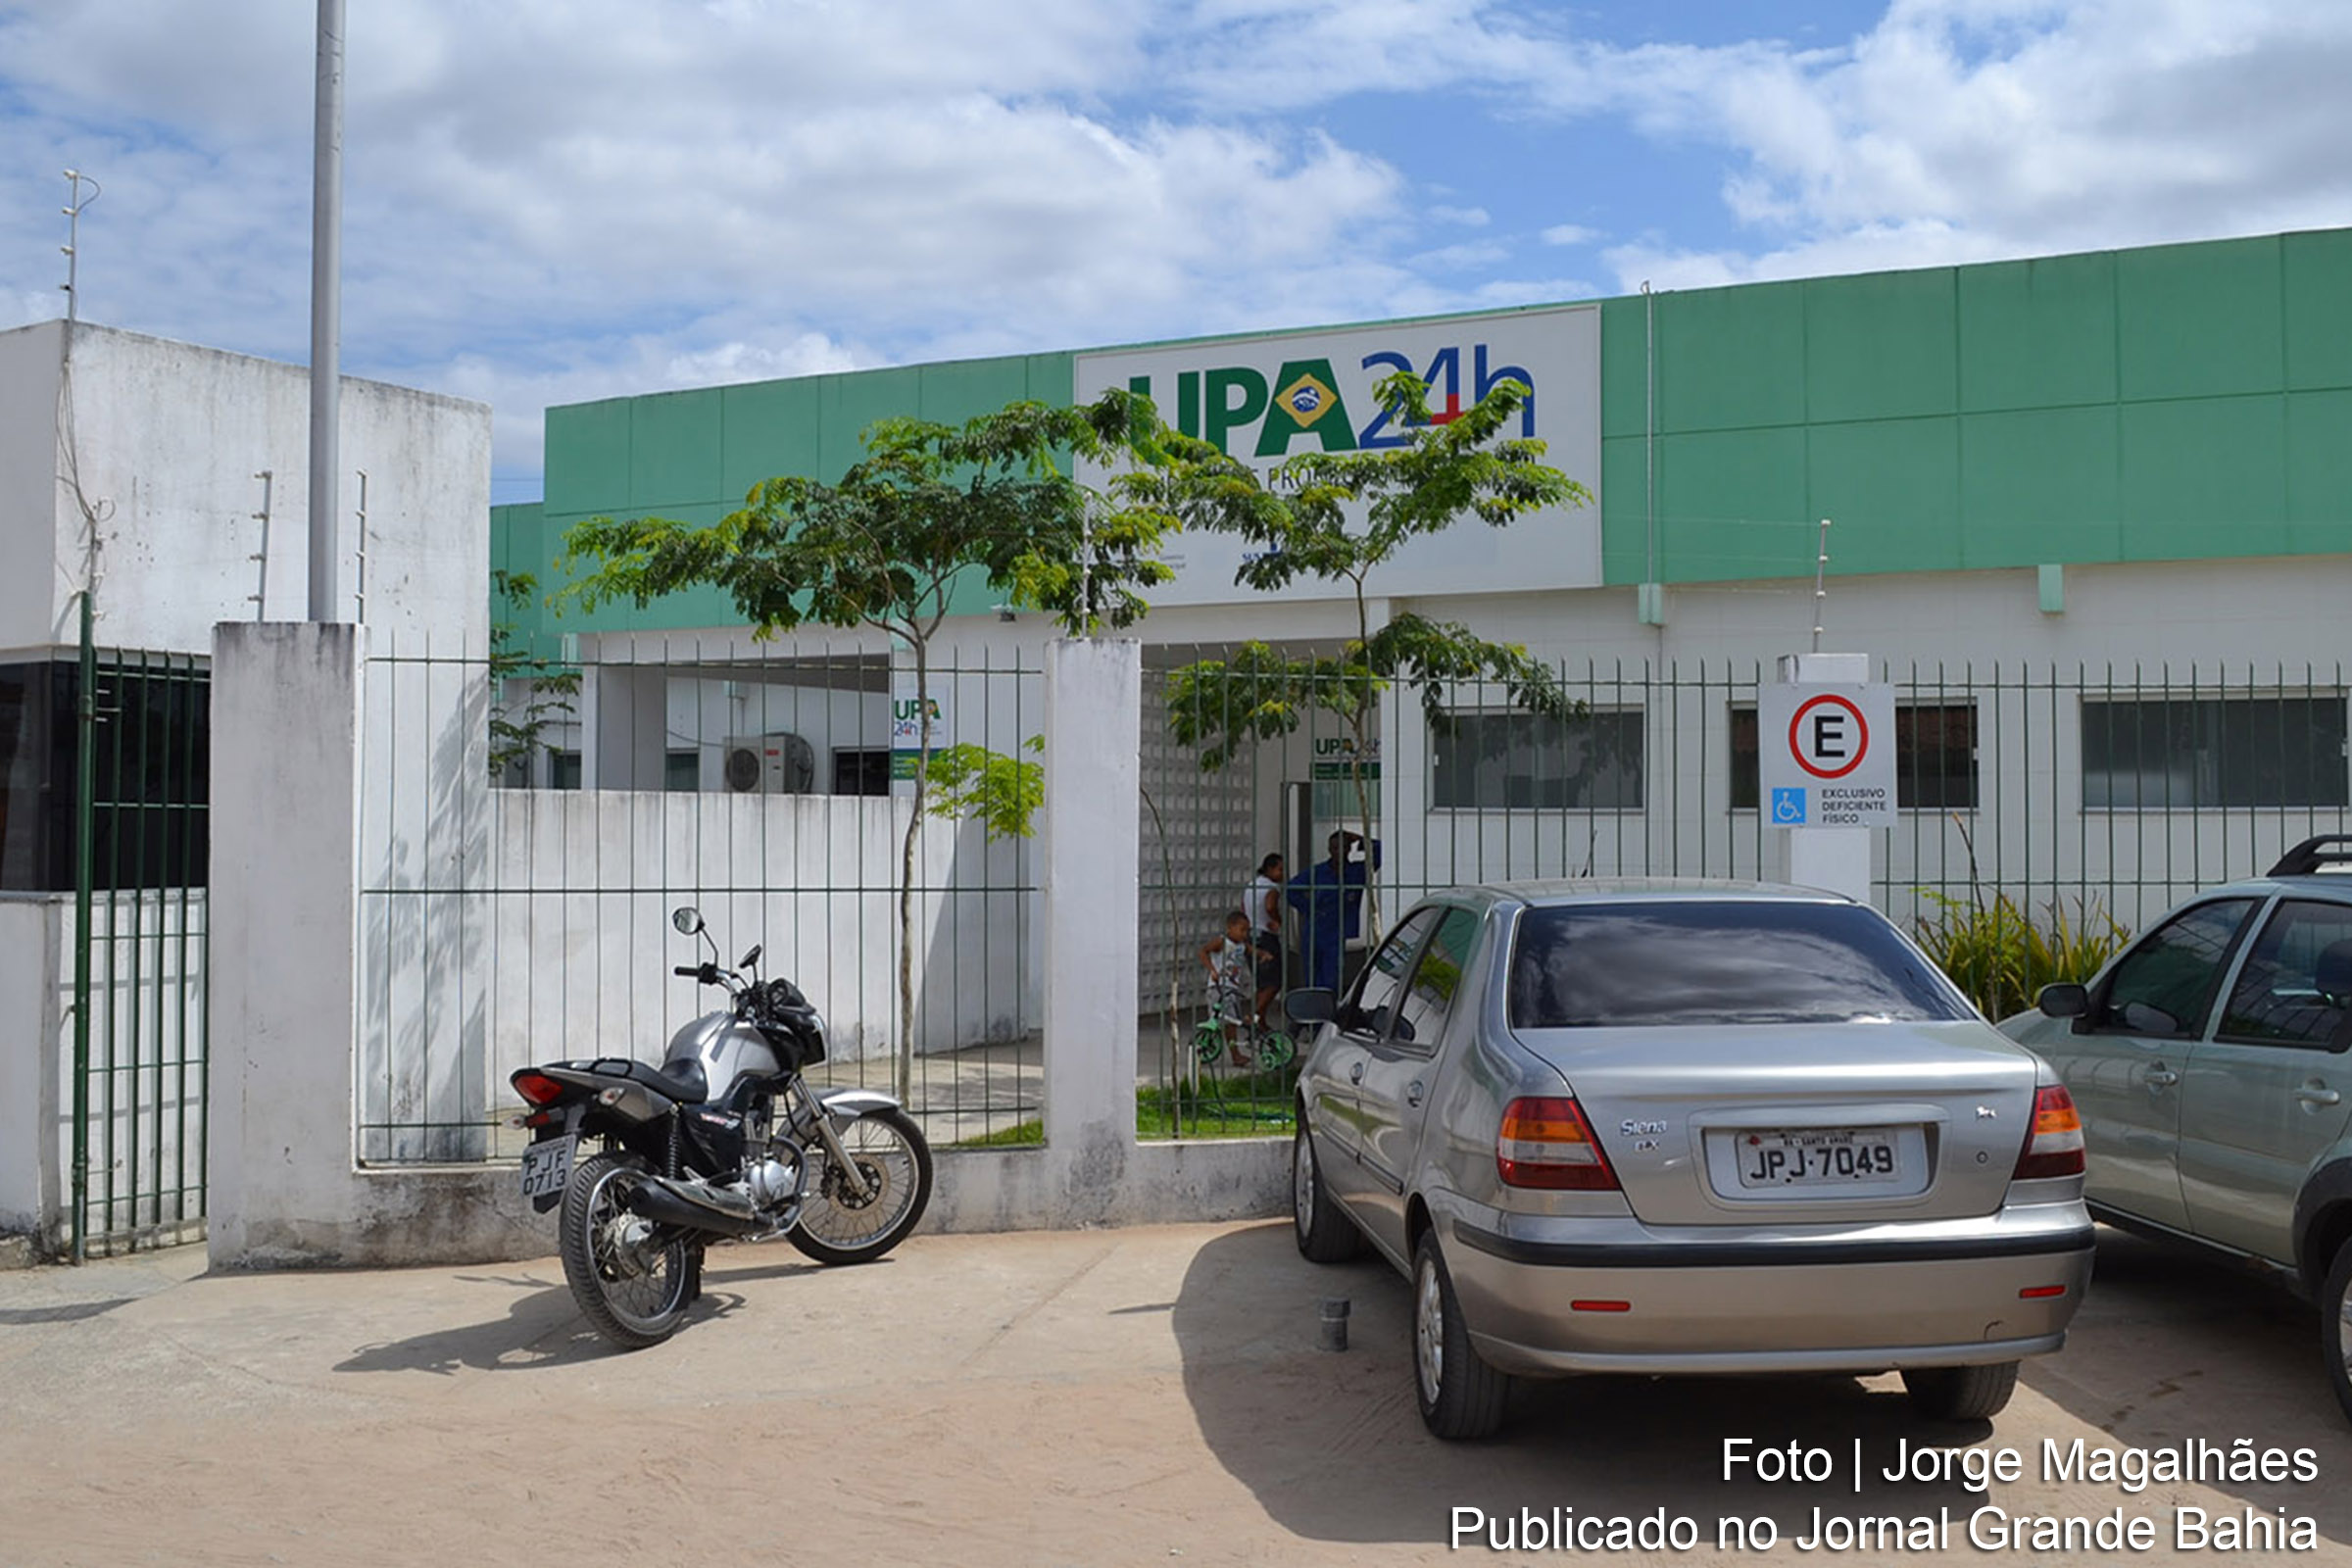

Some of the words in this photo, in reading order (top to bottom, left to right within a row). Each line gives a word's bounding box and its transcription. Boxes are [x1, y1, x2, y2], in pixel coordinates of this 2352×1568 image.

[1358, 344, 1536, 451] 24h
[895, 699, 942, 720] UPA
[894, 721, 919, 737] 24h
[1815, 715, 1845, 758] E
[1315, 737, 1354, 756] UPA
[1822, 788, 1886, 799] EXCLUSIVO
[1822, 800, 1886, 812] DEFICIENTE
[1822, 812, 1859, 824] FÍSICO
[1620, 1118, 1668, 1136] Siena
[525, 1149, 566, 1176] PJF
[523, 1168, 566, 1196] 0713
